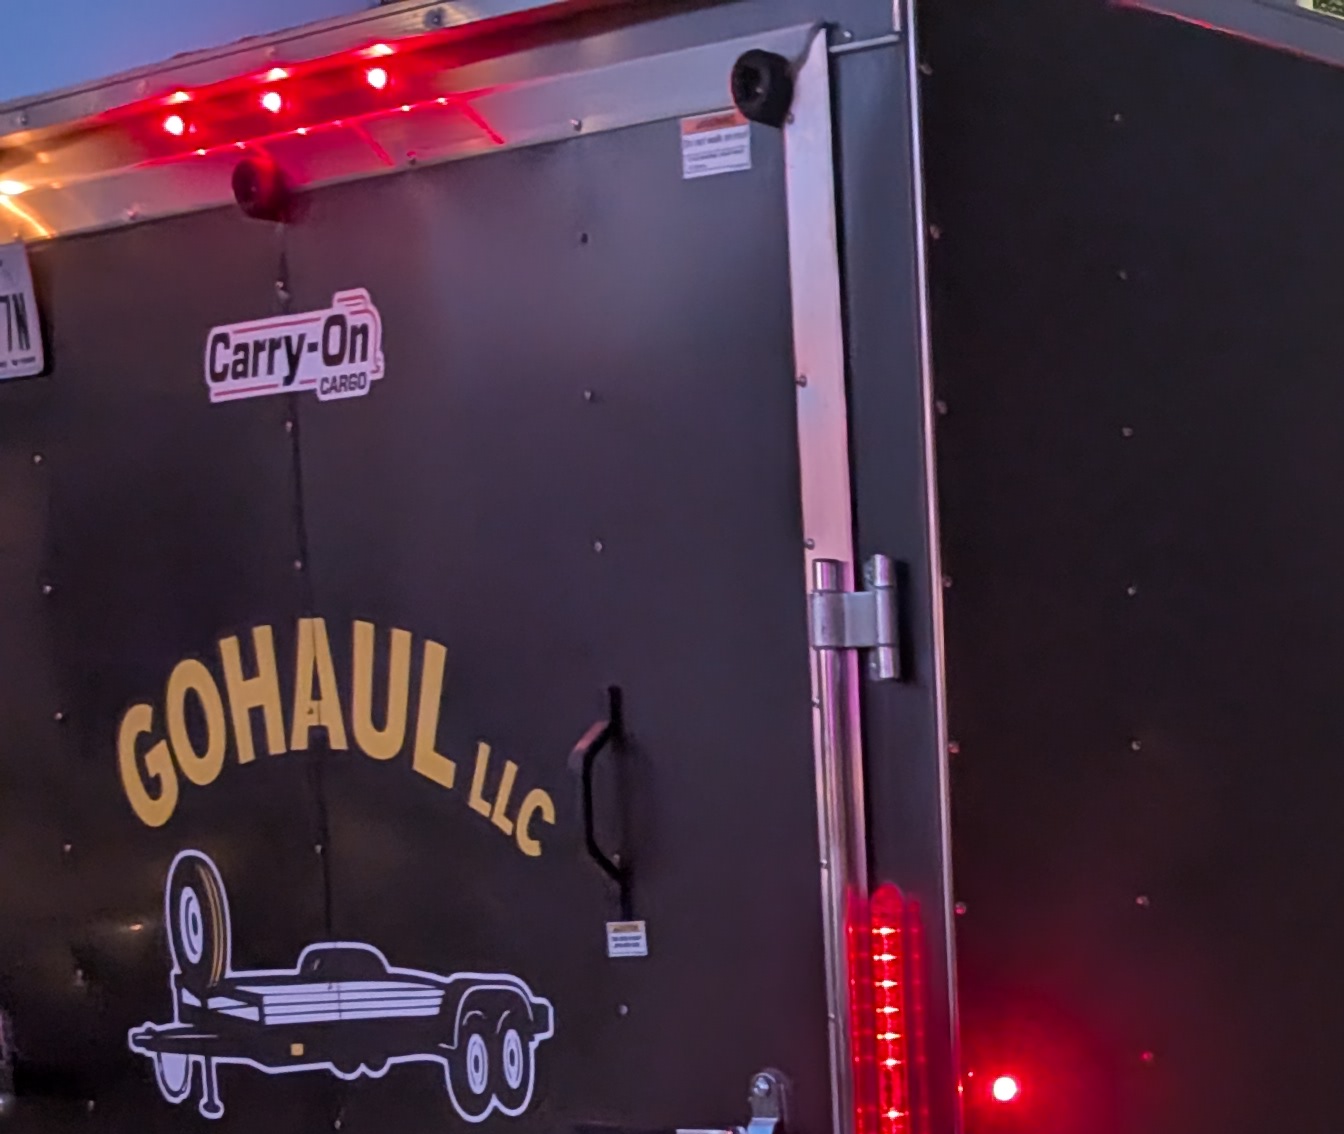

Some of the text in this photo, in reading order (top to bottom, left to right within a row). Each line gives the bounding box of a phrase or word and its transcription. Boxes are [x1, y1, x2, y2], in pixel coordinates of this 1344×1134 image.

[209, 313, 369, 387] Carry-On
[319, 371, 367, 396] CARGO
[117, 617, 556, 858] GOHAUL LLC
